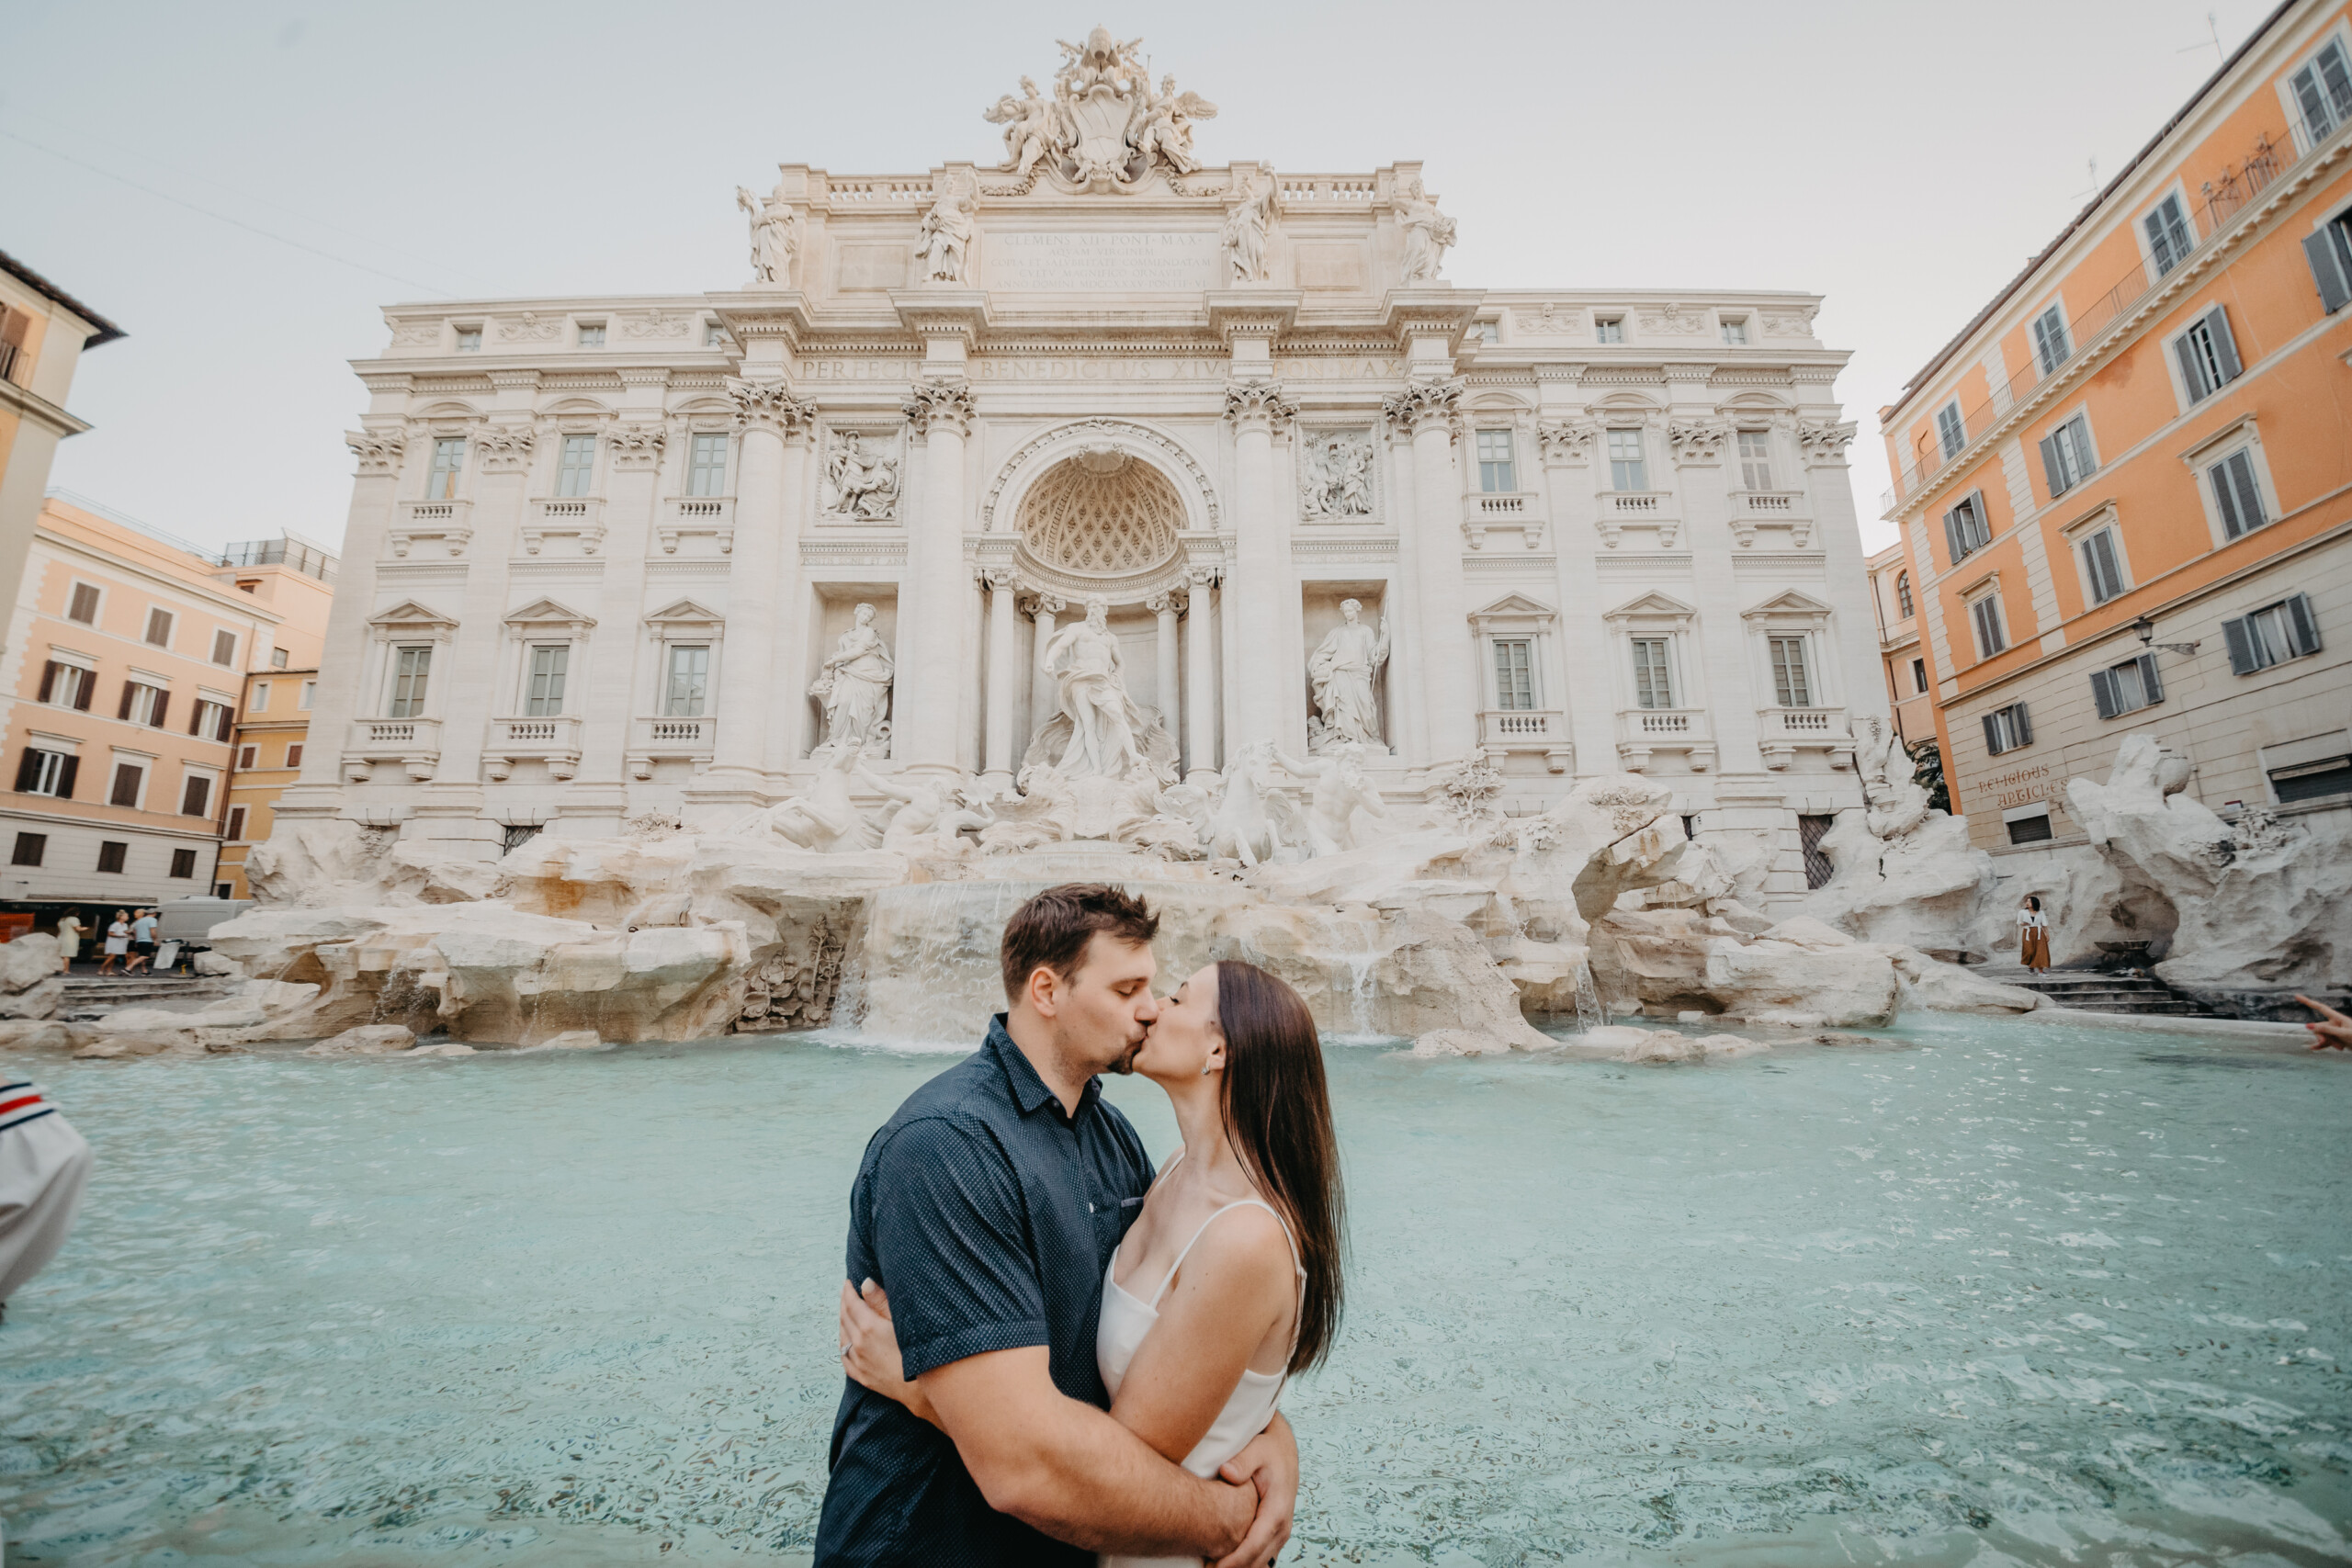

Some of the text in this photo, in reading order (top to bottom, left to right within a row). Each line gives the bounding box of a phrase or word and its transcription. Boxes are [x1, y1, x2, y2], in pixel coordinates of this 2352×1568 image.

[1004, 234, 1071, 245] CLEMENS
[1097, 247, 1154, 256] VIRGINEM
[1029, 258, 1040, 266] ET
[1122, 257, 1211, 266] COMMENDATAM
[1132, 268, 1183, 277] ORNAVIT
[994, 279, 1028, 288] ANNO
[1033, 279, 1074, 288] DOMINI
[801, 361, 922, 378] PERFECIT
[980, 360, 1150, 378] BENEDICTVS
[1978, 763, 2050, 794] RELIGIOUS
[1997, 778, 2068, 807] ARTICLES
